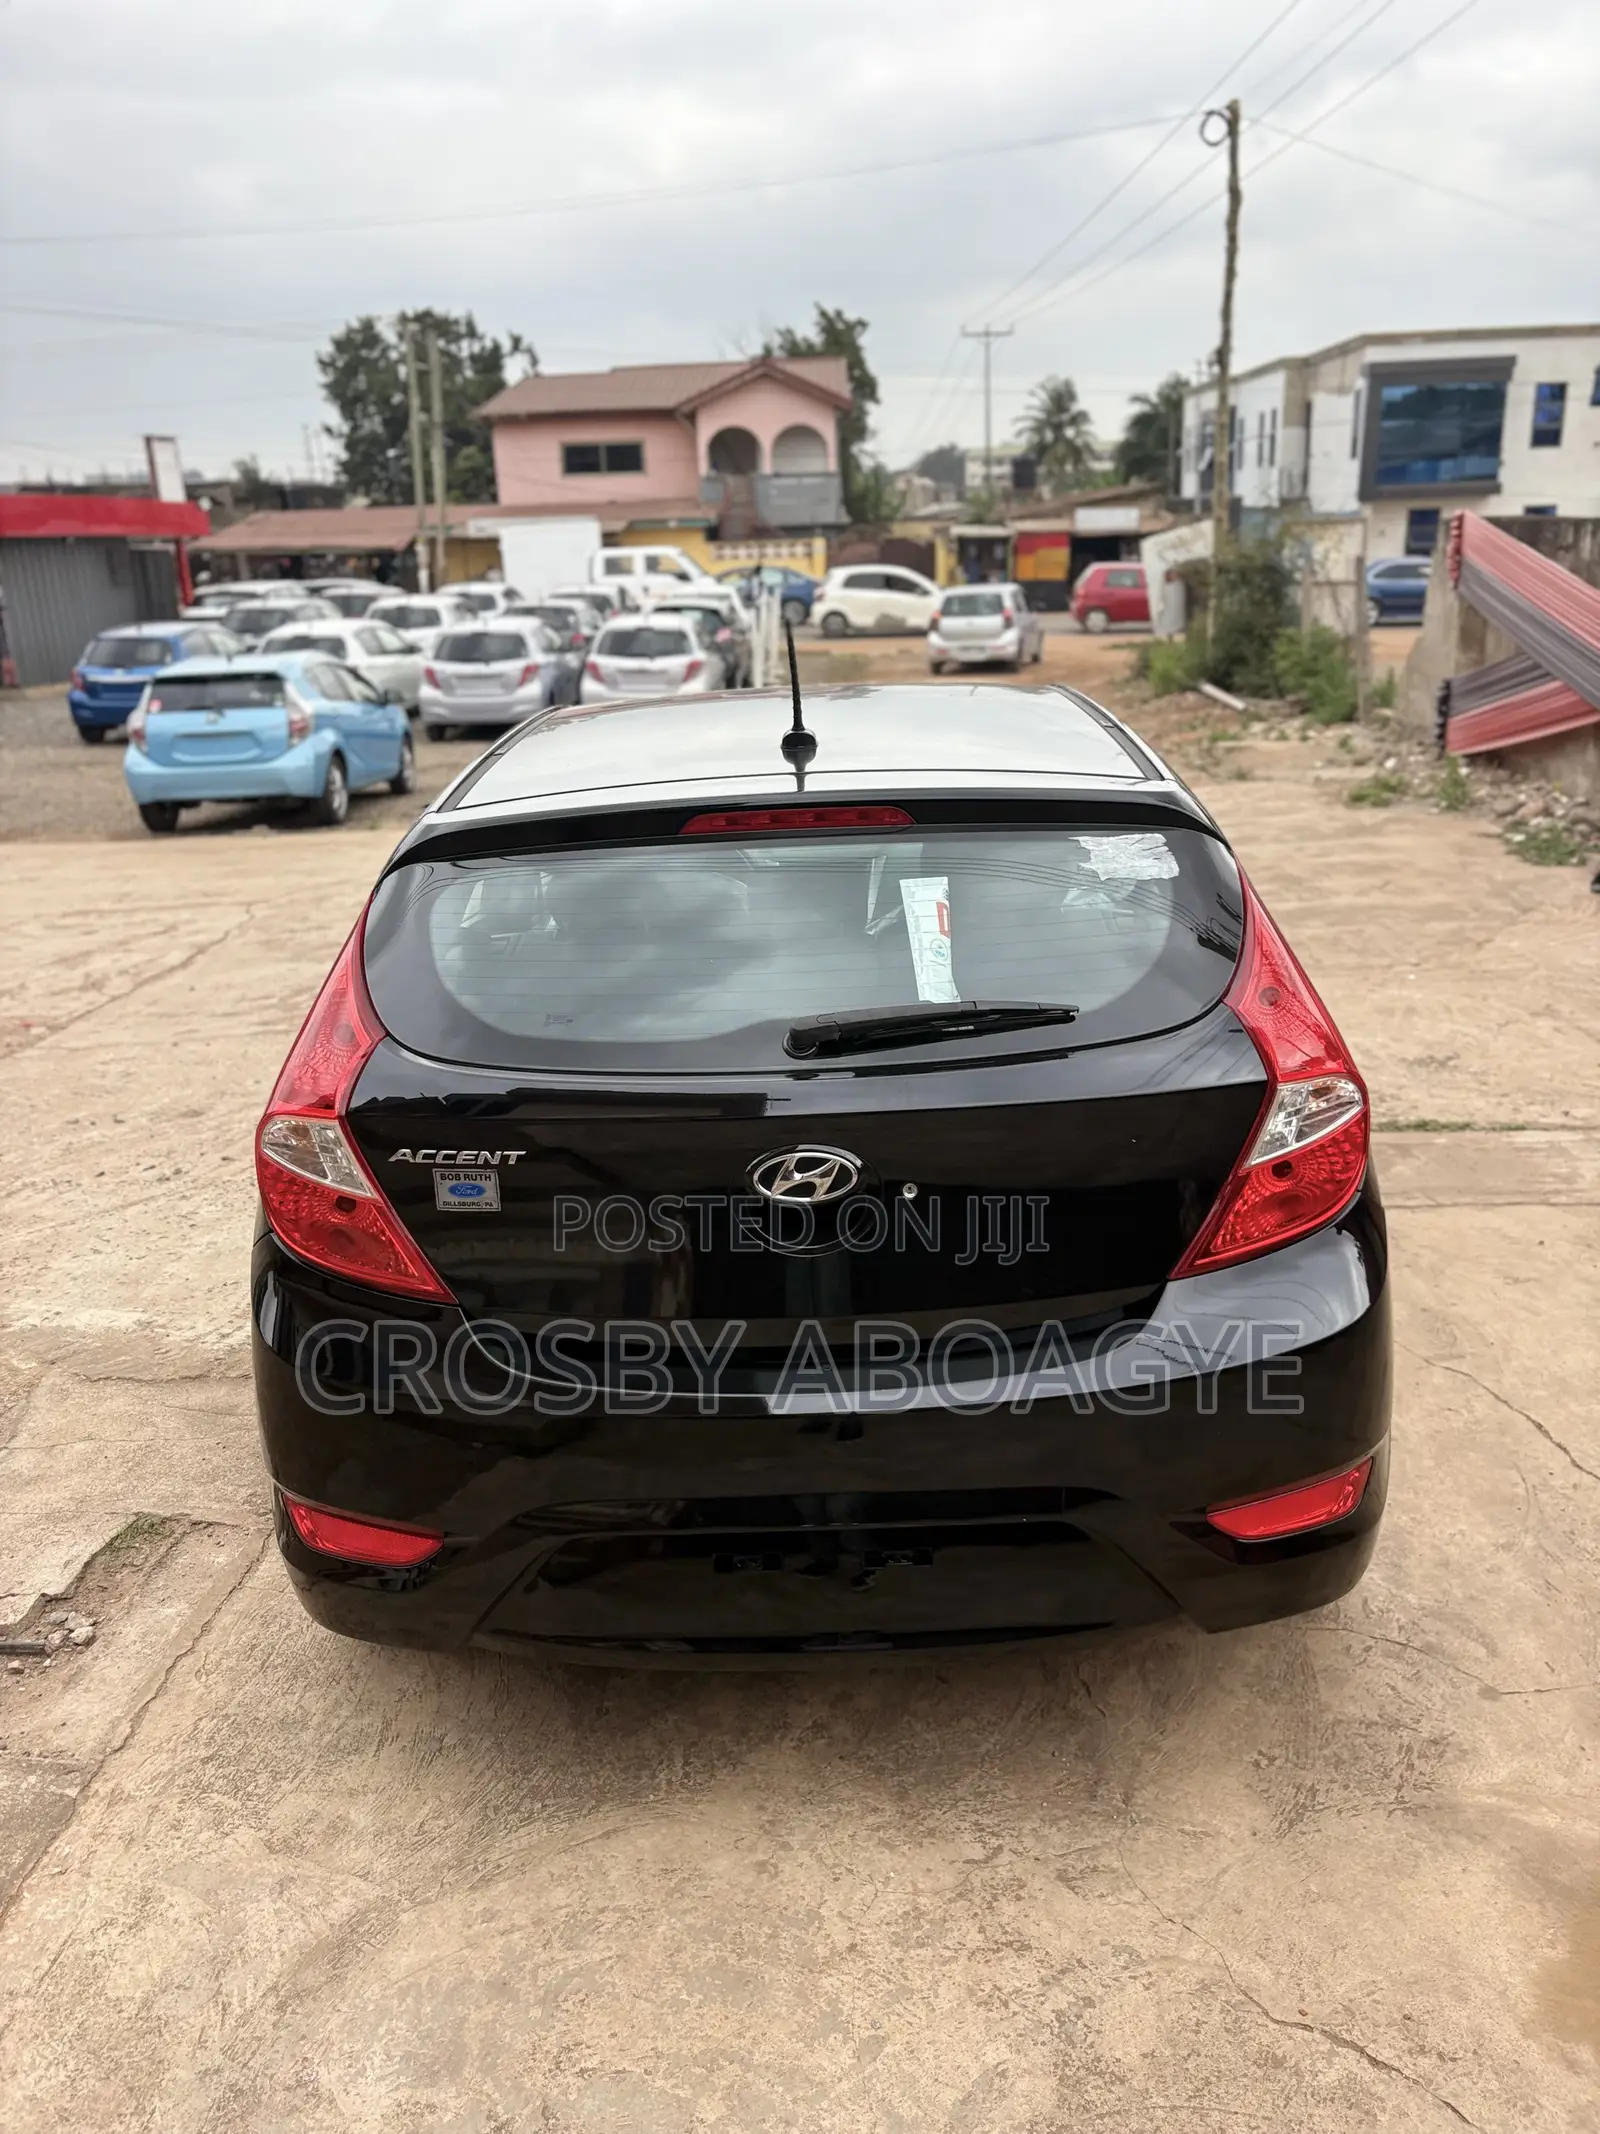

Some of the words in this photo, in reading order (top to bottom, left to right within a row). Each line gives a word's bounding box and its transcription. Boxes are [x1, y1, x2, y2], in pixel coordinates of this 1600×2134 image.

[388, 1148, 527, 1165] ACCENT
[440, 1173, 461, 1181] BOB
[463, 1173, 492, 1182] RUTH
[455, 1184, 479, 1195] Ford
